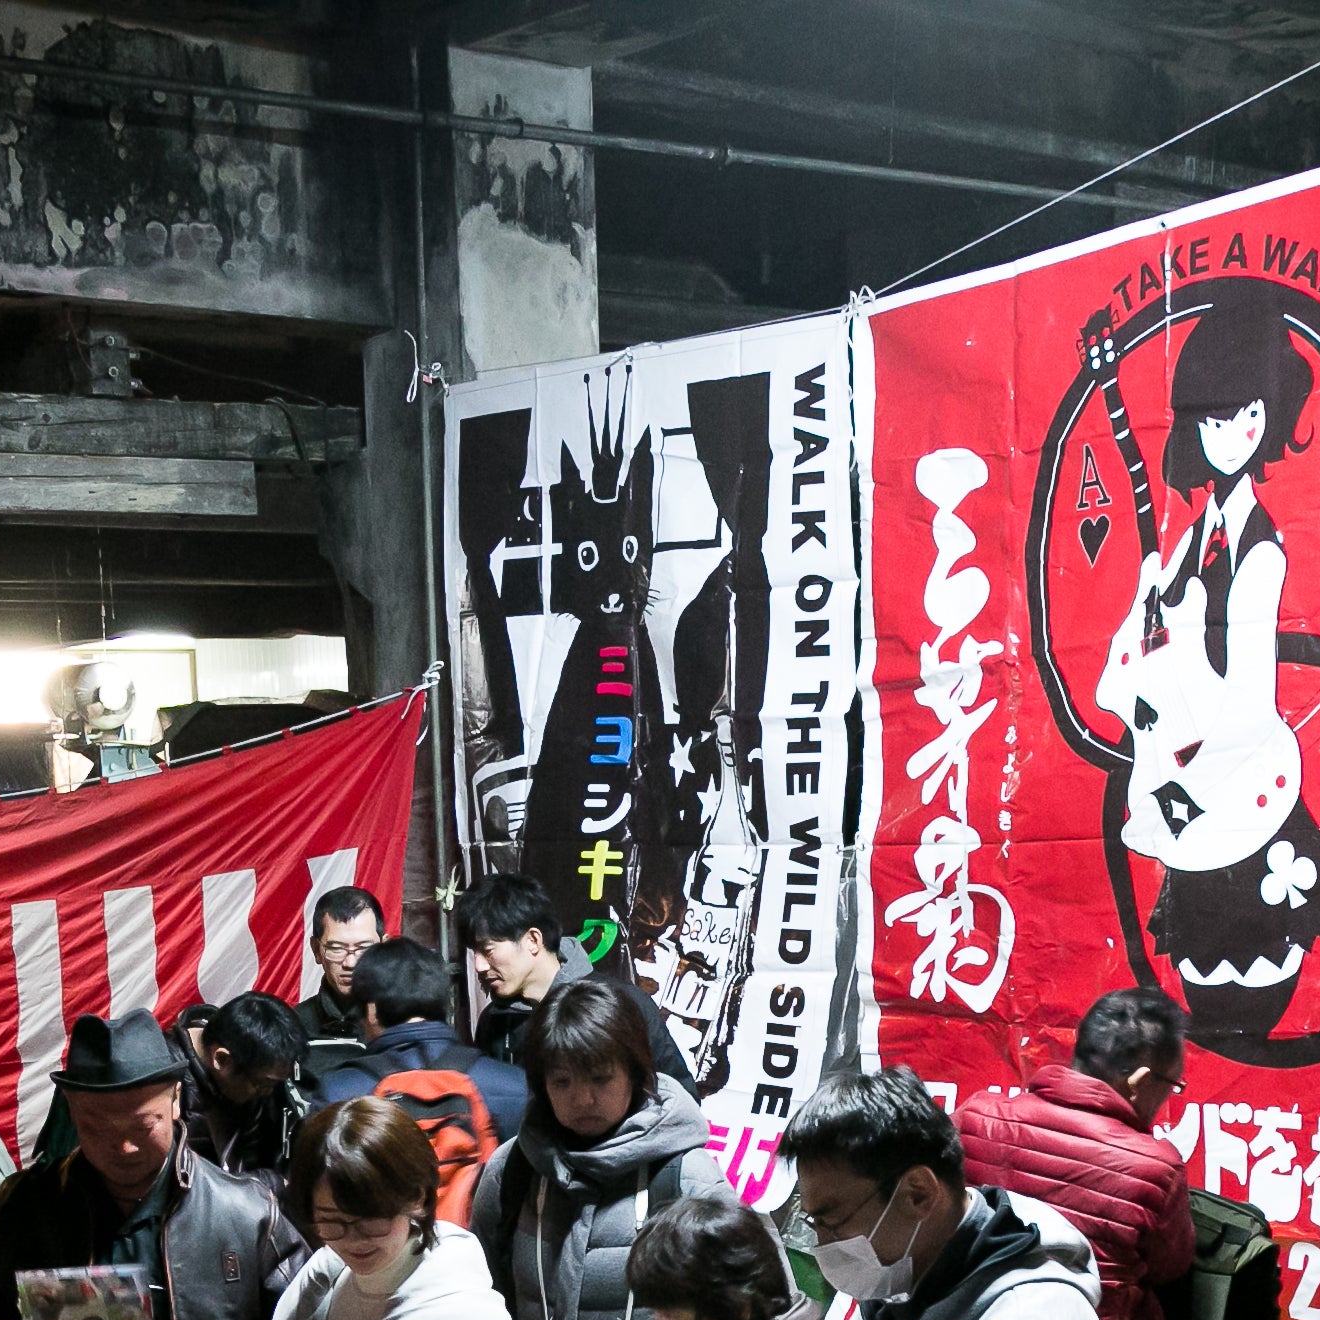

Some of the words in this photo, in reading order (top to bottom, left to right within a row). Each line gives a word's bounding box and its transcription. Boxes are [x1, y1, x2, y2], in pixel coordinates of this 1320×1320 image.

[1113, 235, 1210, 312] TAKE
[1221, 233, 1248, 269] A
[791, 362, 829, 553] WALK
[1075, 443, 1113, 511] A
[795, 574, 833, 658] ON
[785, 680, 829, 797] THE
[681, 908, 732, 944] Sake
[778, 816, 820, 965] WILD
[750, 984, 806, 1119] SIDE
